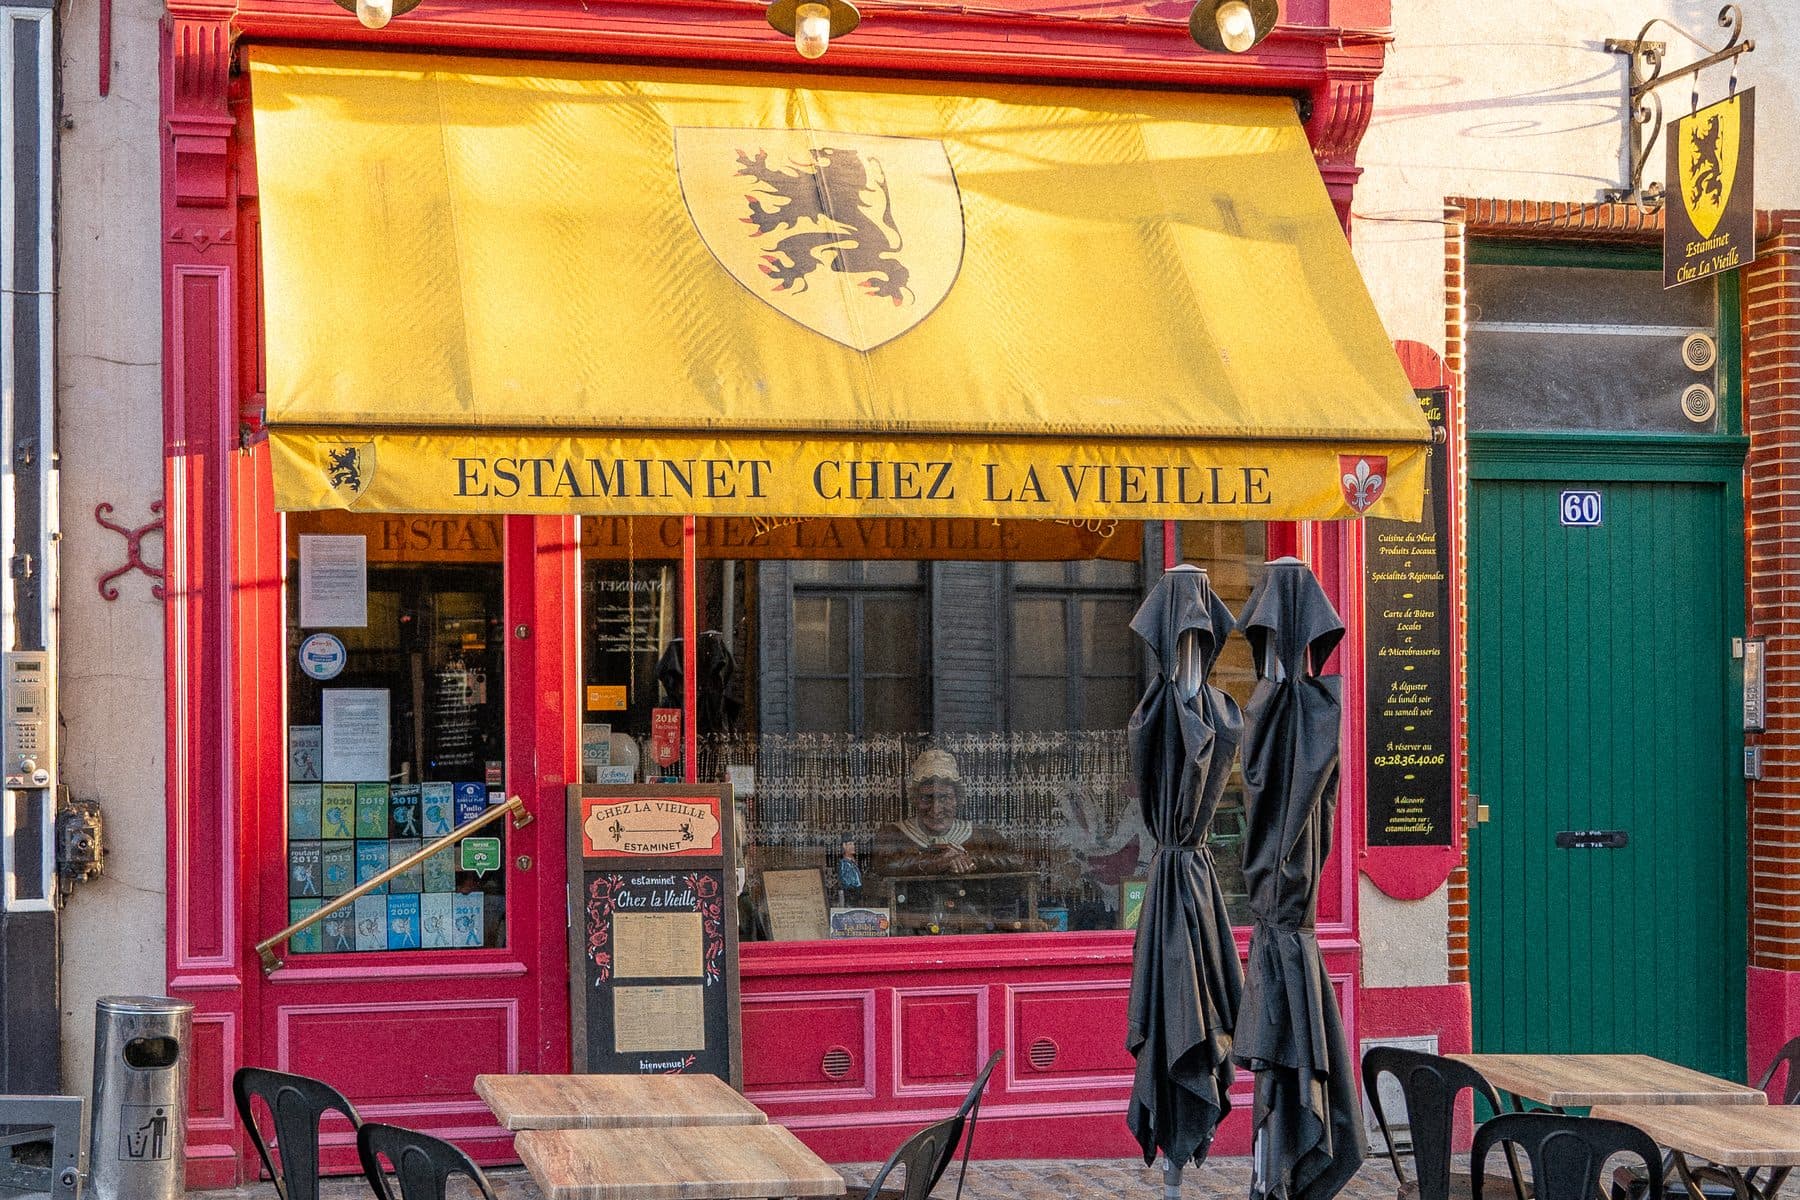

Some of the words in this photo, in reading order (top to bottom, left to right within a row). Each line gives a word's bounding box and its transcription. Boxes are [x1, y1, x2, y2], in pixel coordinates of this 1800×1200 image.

[1685, 232, 1730, 258] Estaminet
[1677, 262, 1697, 282] Chez
[1698, 261, 1711, 276] La
[1712, 246, 1739, 270] Vieille
[452, 457, 772, 499] ESTAMINET
[813, 460, 955, 501] CHEZ
[981, 463, 1050, 503] LA
[1057, 464, 1272, 504] VIEILLE
[1564, 494, 1598, 522] 60
[1378, 533, 1404, 542] Cuisine
[1405, 532, 1415, 542] du
[1416, 532, 1437, 542] Nord
[1379, 545, 1409, 555] Produits
[1410, 546, 1437, 555] Locaux
[1404, 560, 1412, 568] et
[1371, 570, 1407, 583] Spécialités
[1408, 570, 1445, 583] Régionales
[1383, 609, 1403, 618] Carte
[1404, 608, 1412, 618] de
[1413, 609, 1435, 618] Bières
[1396, 620, 1422, 631] Locales
[1378, 646, 1387, 656] de
[1388, 646, 1441, 656] Microbrasseries
[1399, 680, 1429, 694] déguster
[1387, 694, 1397, 704] du
[1398, 694, 1418, 704] lundi
[1418, 695, 1432, 704] soir
[1394, 706, 1419, 716] samedi
[1420, 708, 1434, 716] soir
[1395, 742, 1422, 751] réserver
[1374, 754, 1445, 767] 03.28.36.40.06
[424, 796, 450, 805] 2017
[596, 804, 631, 822] CHEZ
[635, 803, 652, 812] LA
[655, 802, 706, 820] VIEILLE
[624, 841, 681, 852] ESTAMINET
[631, 874, 676, 886] estaminet
[617, 890, 647, 908] Chez
[650, 890, 663, 907] la
[664, 890, 696, 907] Vieille
[640, 1057, 685, 1069] bienvenue!
